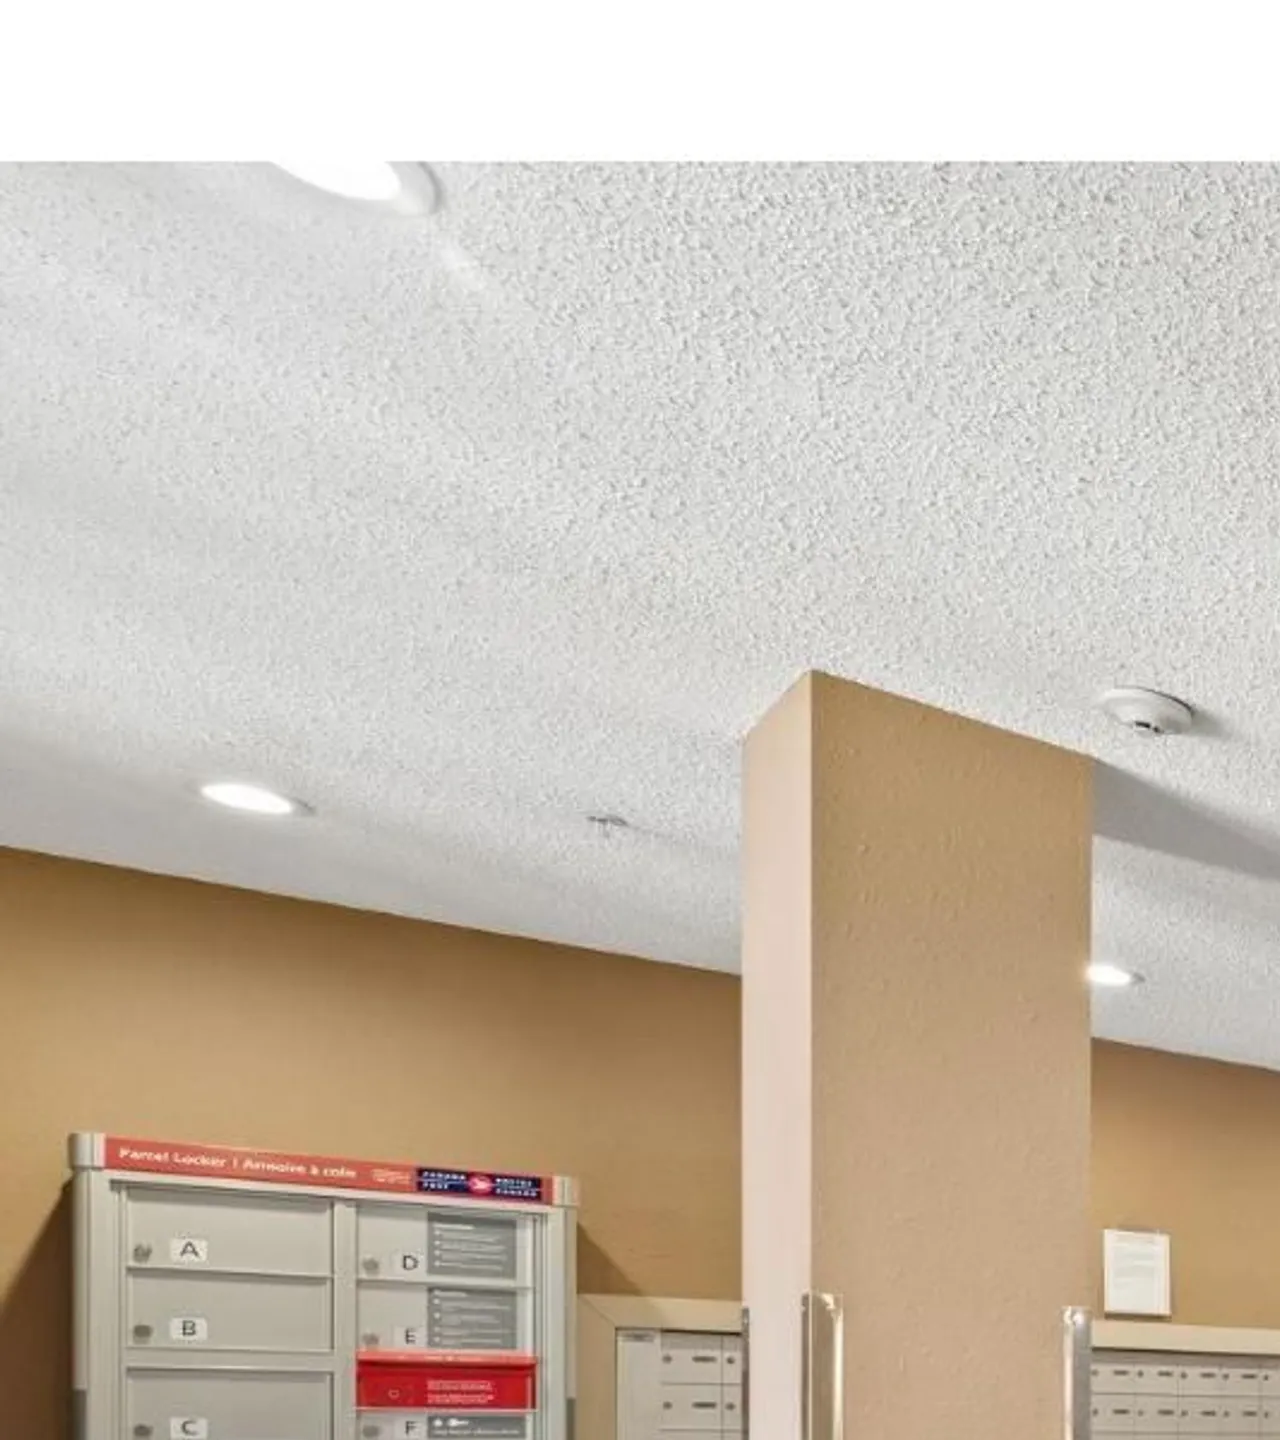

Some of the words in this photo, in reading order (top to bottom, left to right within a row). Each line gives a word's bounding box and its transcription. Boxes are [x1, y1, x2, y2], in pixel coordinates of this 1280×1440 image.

[119, 1147, 169, 1162] Parcel
[173, 1152, 226, 1168] Locker
[180, 1241, 200, 1258] A
[403, 1255, 419, 1271] D
[182, 1320, 197, 1337] B
[405, 1328, 416, 1345] E
[181, 1420, 198, 1436] C
[405, 1420, 417, 1436] F
